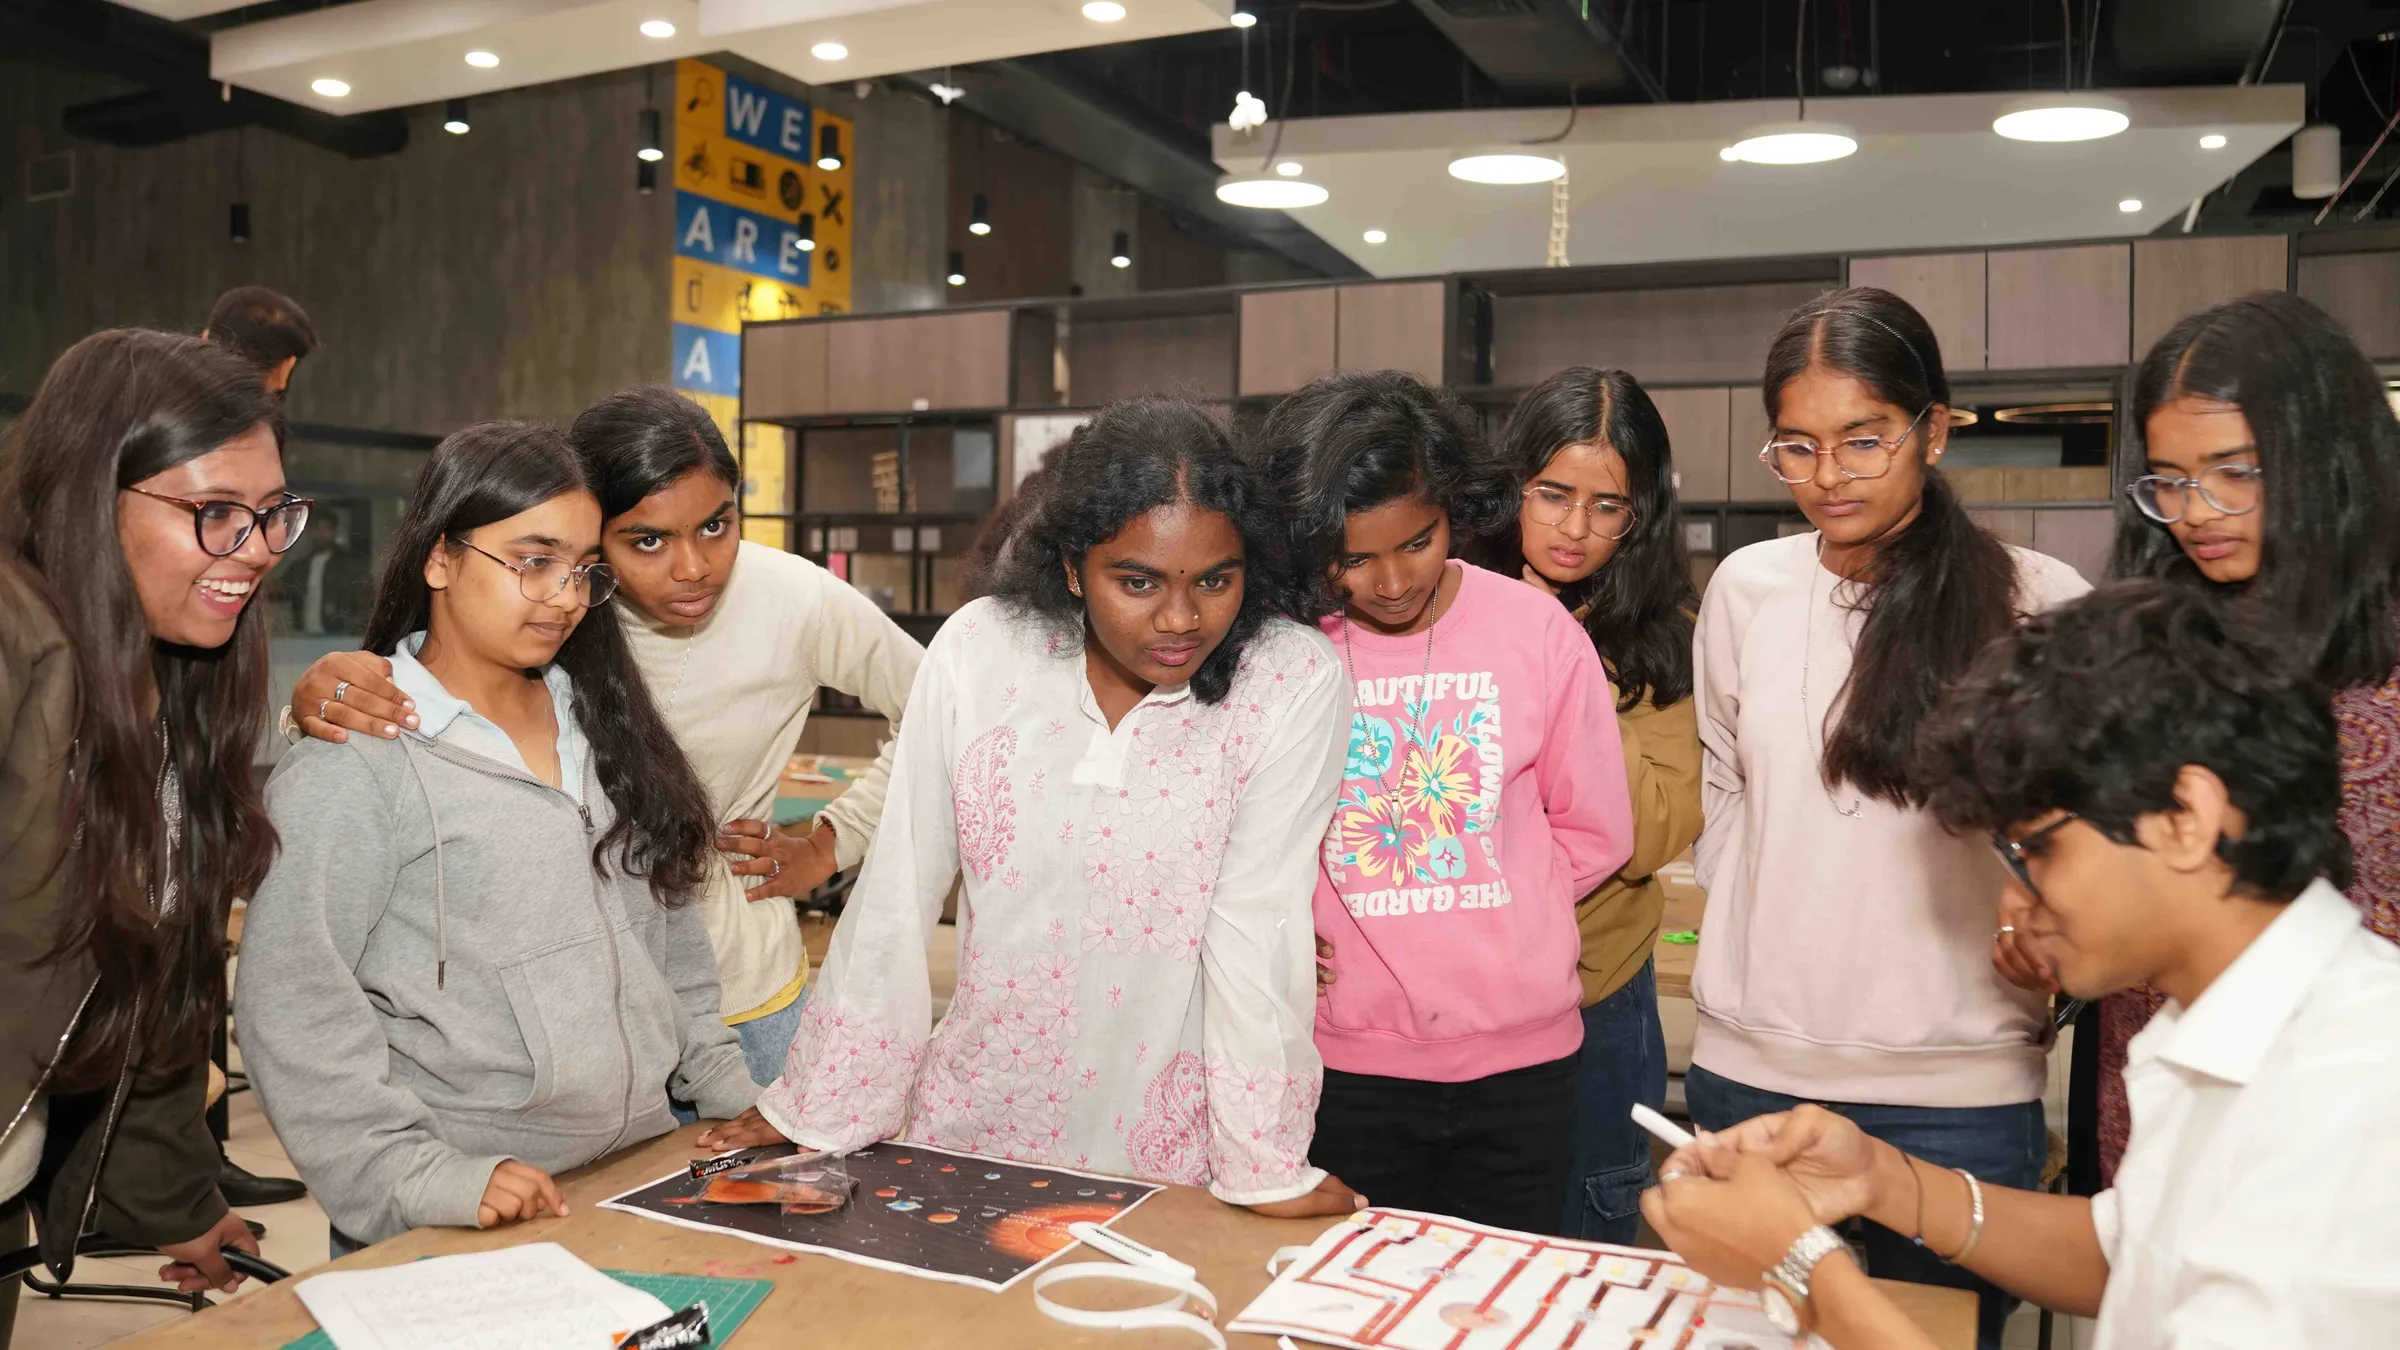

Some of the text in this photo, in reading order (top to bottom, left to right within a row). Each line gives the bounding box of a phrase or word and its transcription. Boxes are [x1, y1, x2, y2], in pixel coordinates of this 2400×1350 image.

[729, 87, 803, 151] WE
[685, 206, 800, 275] ARE
[1353, 672, 1499, 706] AUTIFUL
[1343, 885, 1453, 917] GARDE
